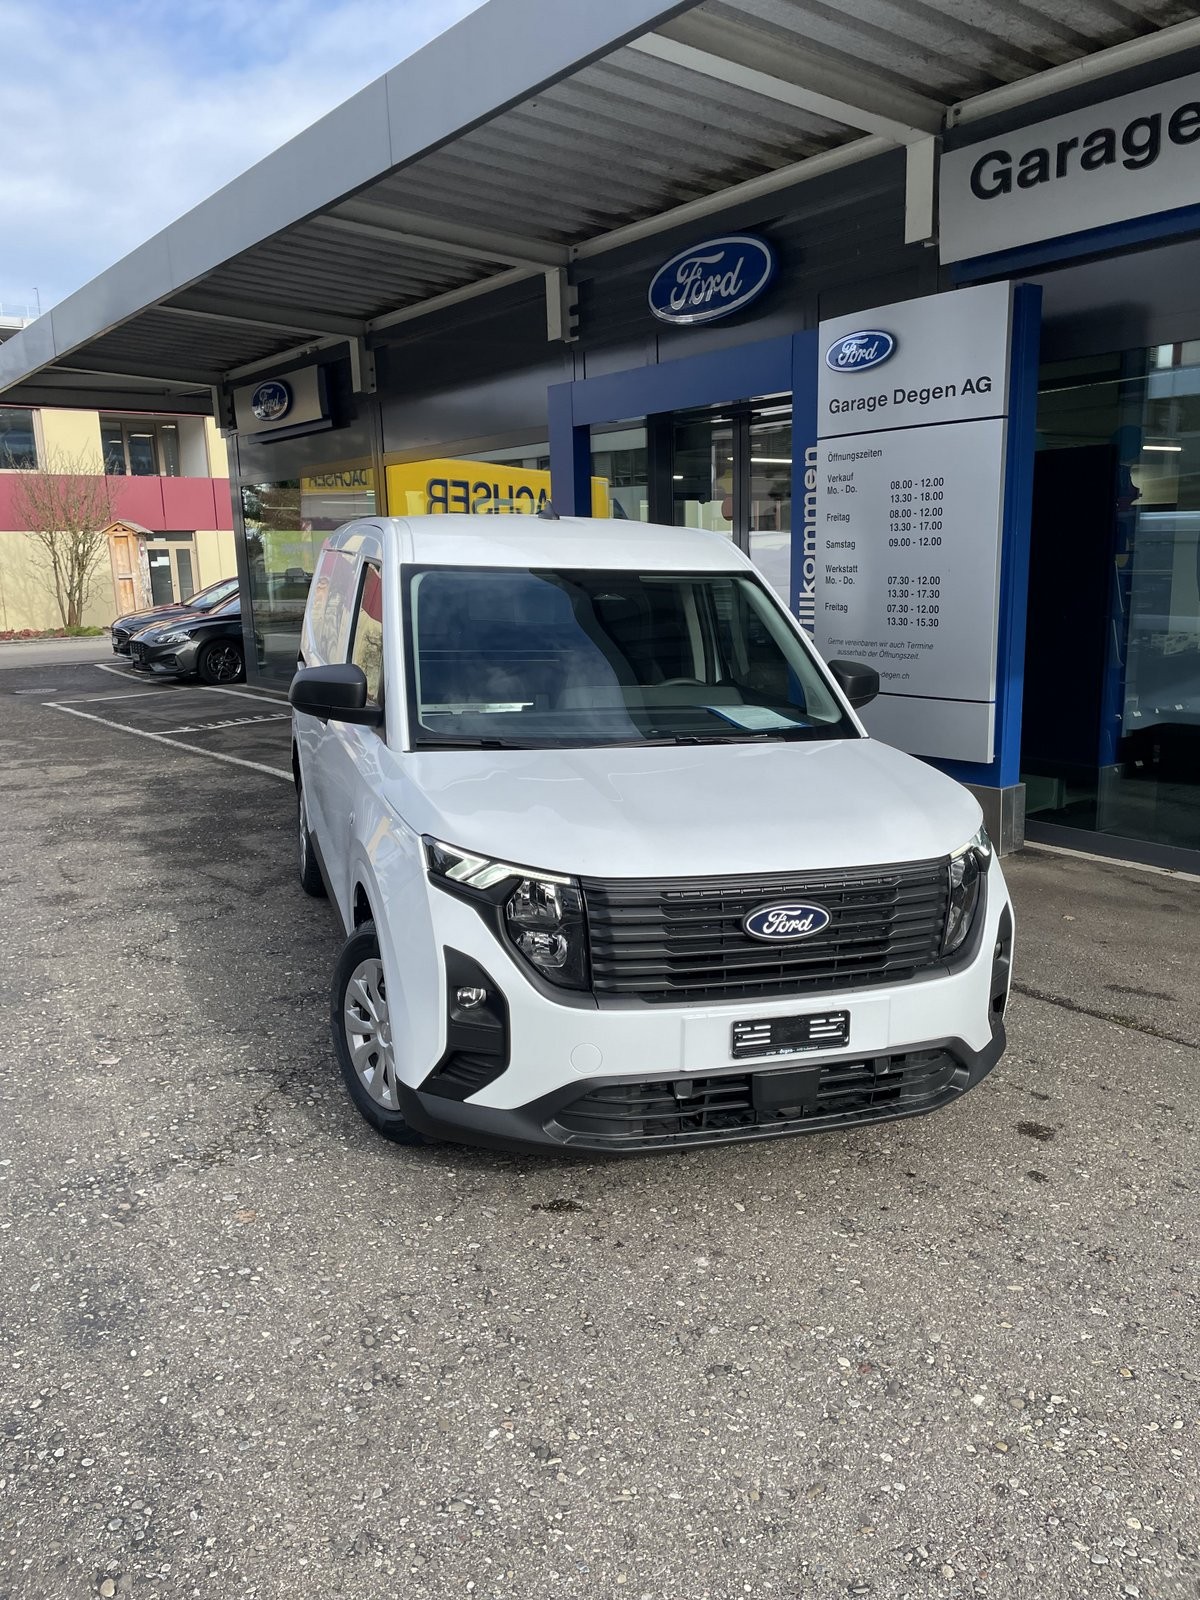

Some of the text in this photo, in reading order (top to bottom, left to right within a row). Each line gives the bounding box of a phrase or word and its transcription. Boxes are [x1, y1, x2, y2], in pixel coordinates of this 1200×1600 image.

[970, 101, 1200, 200] Garage
[670, 251, 745, 310] Ford
[838, 337, 878, 366] Ford
[256, 387, 282, 414] Ford
[829, 376, 992, 414] Garage Degen AG
[827, 449, 883, 463] Öffnungszeiten
[827, 472, 854, 483] Verkauf
[890, 480, 912, 490] 08.00
[920, 477, 944, 488] 12.00
[827, 486, 840, 495] Mo.
[845, 484, 858, 494] Do.
[890, 493, 912, 504] 13.30
[920, 491, 944, 502] 18.00
[826, 513, 850, 523] Freitag
[890, 508, 912, 519] 08.00
[920, 507, 942, 518] 12.00
[890, 523, 911, 532] 13.30
[920, 521, 942, 531] 17.00
[826, 540, 856, 550] Samstag
[888, 538, 910, 548] 09.00
[918, 536, 942, 547] 12.00
[826, 564, 858, 574] Werkstatt
[825, 576, 838, 585] Mo.
[843, 576, 856, 585] Do.
[888, 576, 910, 586] 07.30
[917, 576, 940, 586] 12.00
[888, 589, 910, 598] 13.30
[916, 590, 940, 598] 17.30
[824, 602, 848, 614] Freitag
[886, 604, 909, 614] 07.30
[916, 604, 940, 614] 12.00
[887, 617, 908, 626] 13.30
[916, 618, 939, 628] 15.30
[828, 638, 844, 646] Gerne
[845, 640, 878, 648] vereinbaren
[907, 642, 934, 650] Termine
[837, 649, 867, 657] ausserhalb
[879, 671, 910, 680] -degen.ch
[762, 910, 814, 934] Ford
